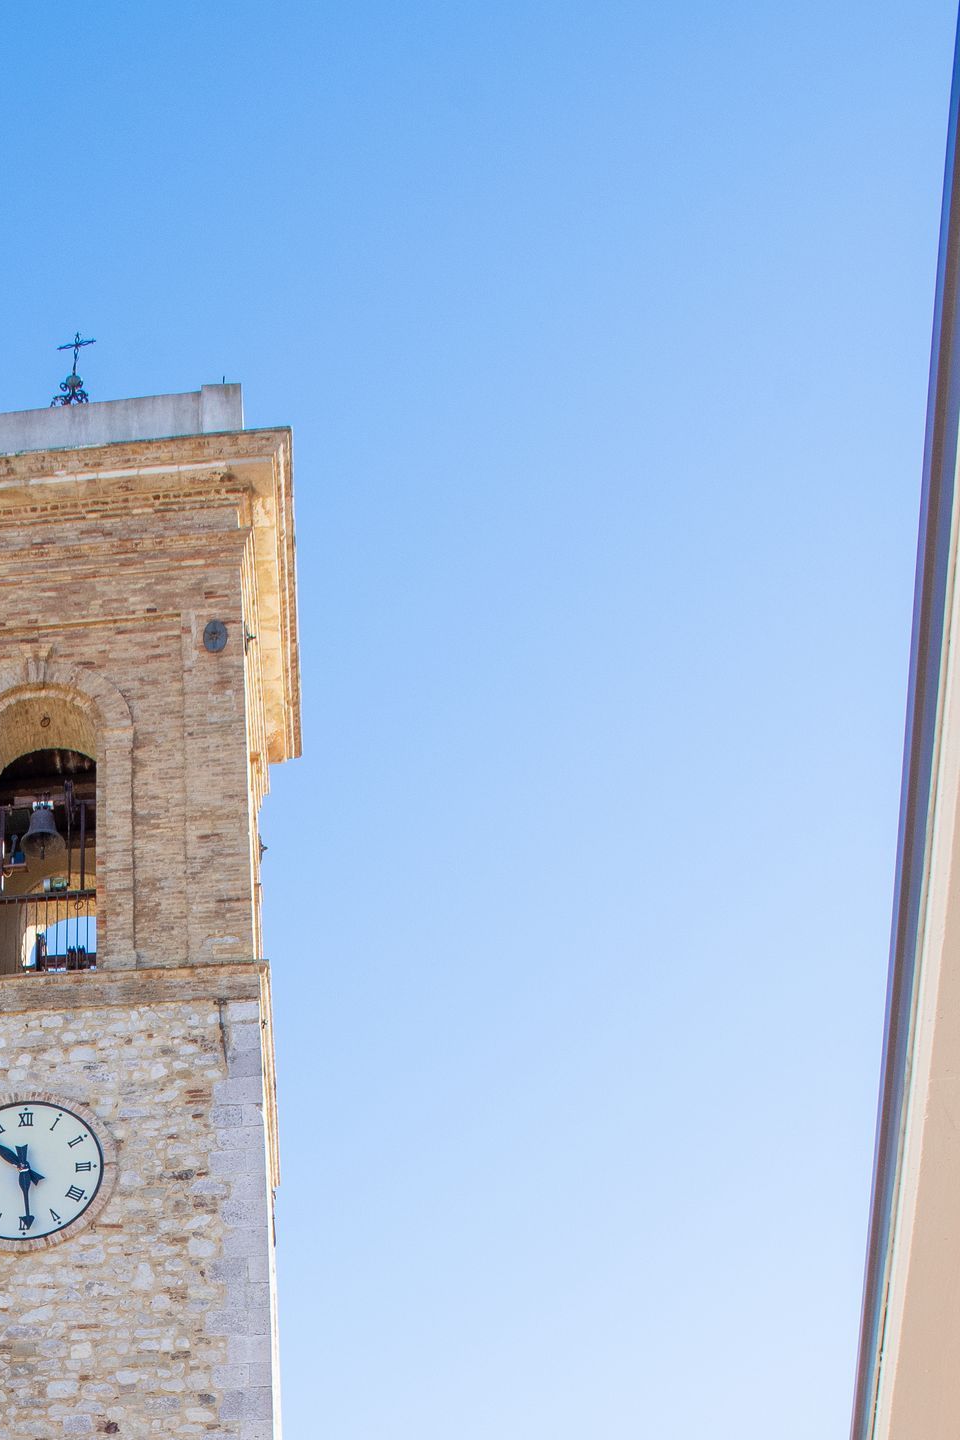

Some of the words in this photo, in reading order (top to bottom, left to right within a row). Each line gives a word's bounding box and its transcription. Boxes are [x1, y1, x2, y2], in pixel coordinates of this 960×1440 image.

[18, 1112, 34, 1127] XII
[50, 1118, 60, 1131] I
[68, 1136, 84, 1148] II
[75, 1161, 92, 1172] III
[65, 1184, 86, 1202] IIII
[49, 1208, 60, 1222] V
